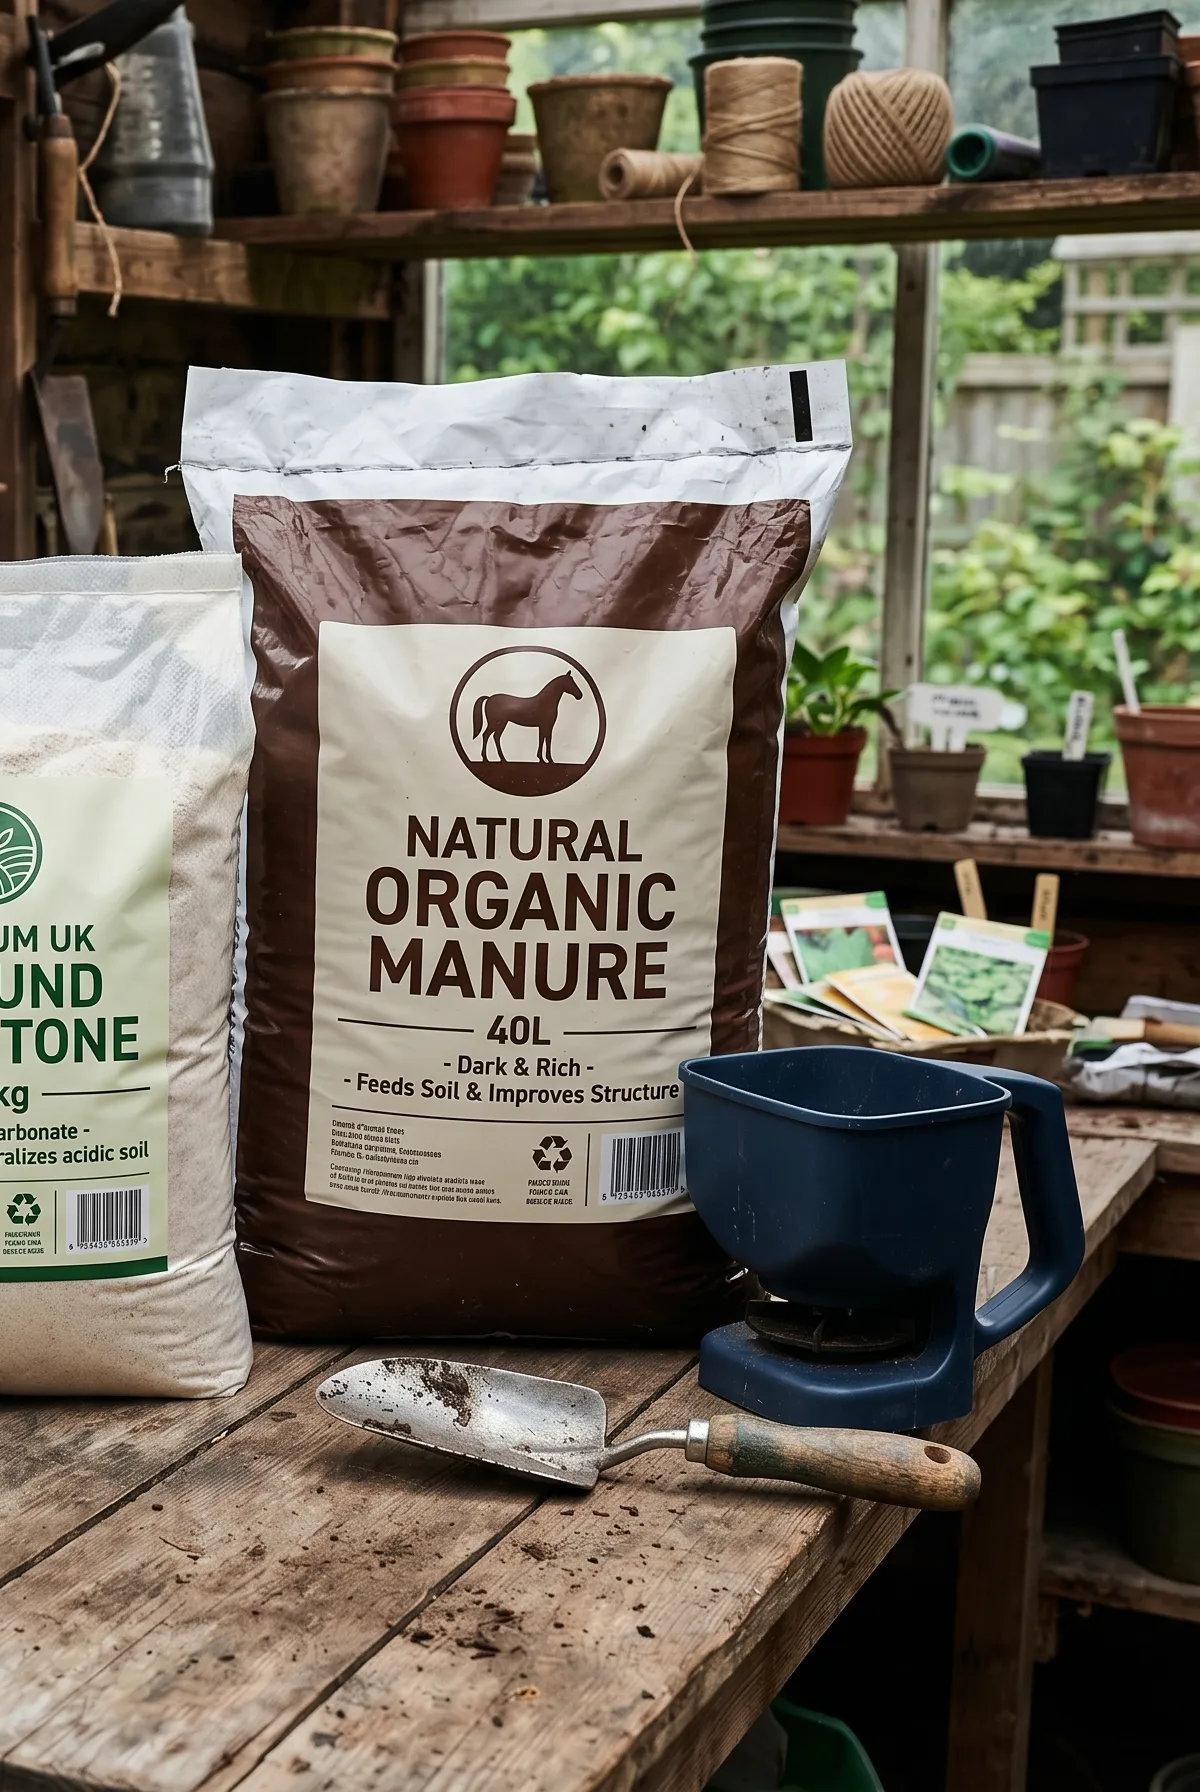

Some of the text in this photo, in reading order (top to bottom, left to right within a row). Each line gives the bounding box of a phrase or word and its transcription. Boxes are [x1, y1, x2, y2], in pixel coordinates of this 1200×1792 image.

[407, 814, 643, 863] NATURAL
[365, 866, 676, 932] ORGANIC
[50, 924, 96, 953] UK
[369, 935, 668, 1002] MANURE
[486, 1015, 551, 1046] 40L
[457, 1054, 508, 1076] Dark
[513, 1056, 530, 1077] &
[536, 1057, 581, 1077] Rich
[357, 1072, 415, 1097] Feeds
[420, 1078, 460, 1100] Soil
[466, 1081, 483, 1102] &
[489, 1083, 585, 1108] Improves
[590, 1083, 680, 1104] Structure
[62, 1144, 115, 1164] acidic
[119, 1140, 149, 1161] soil
